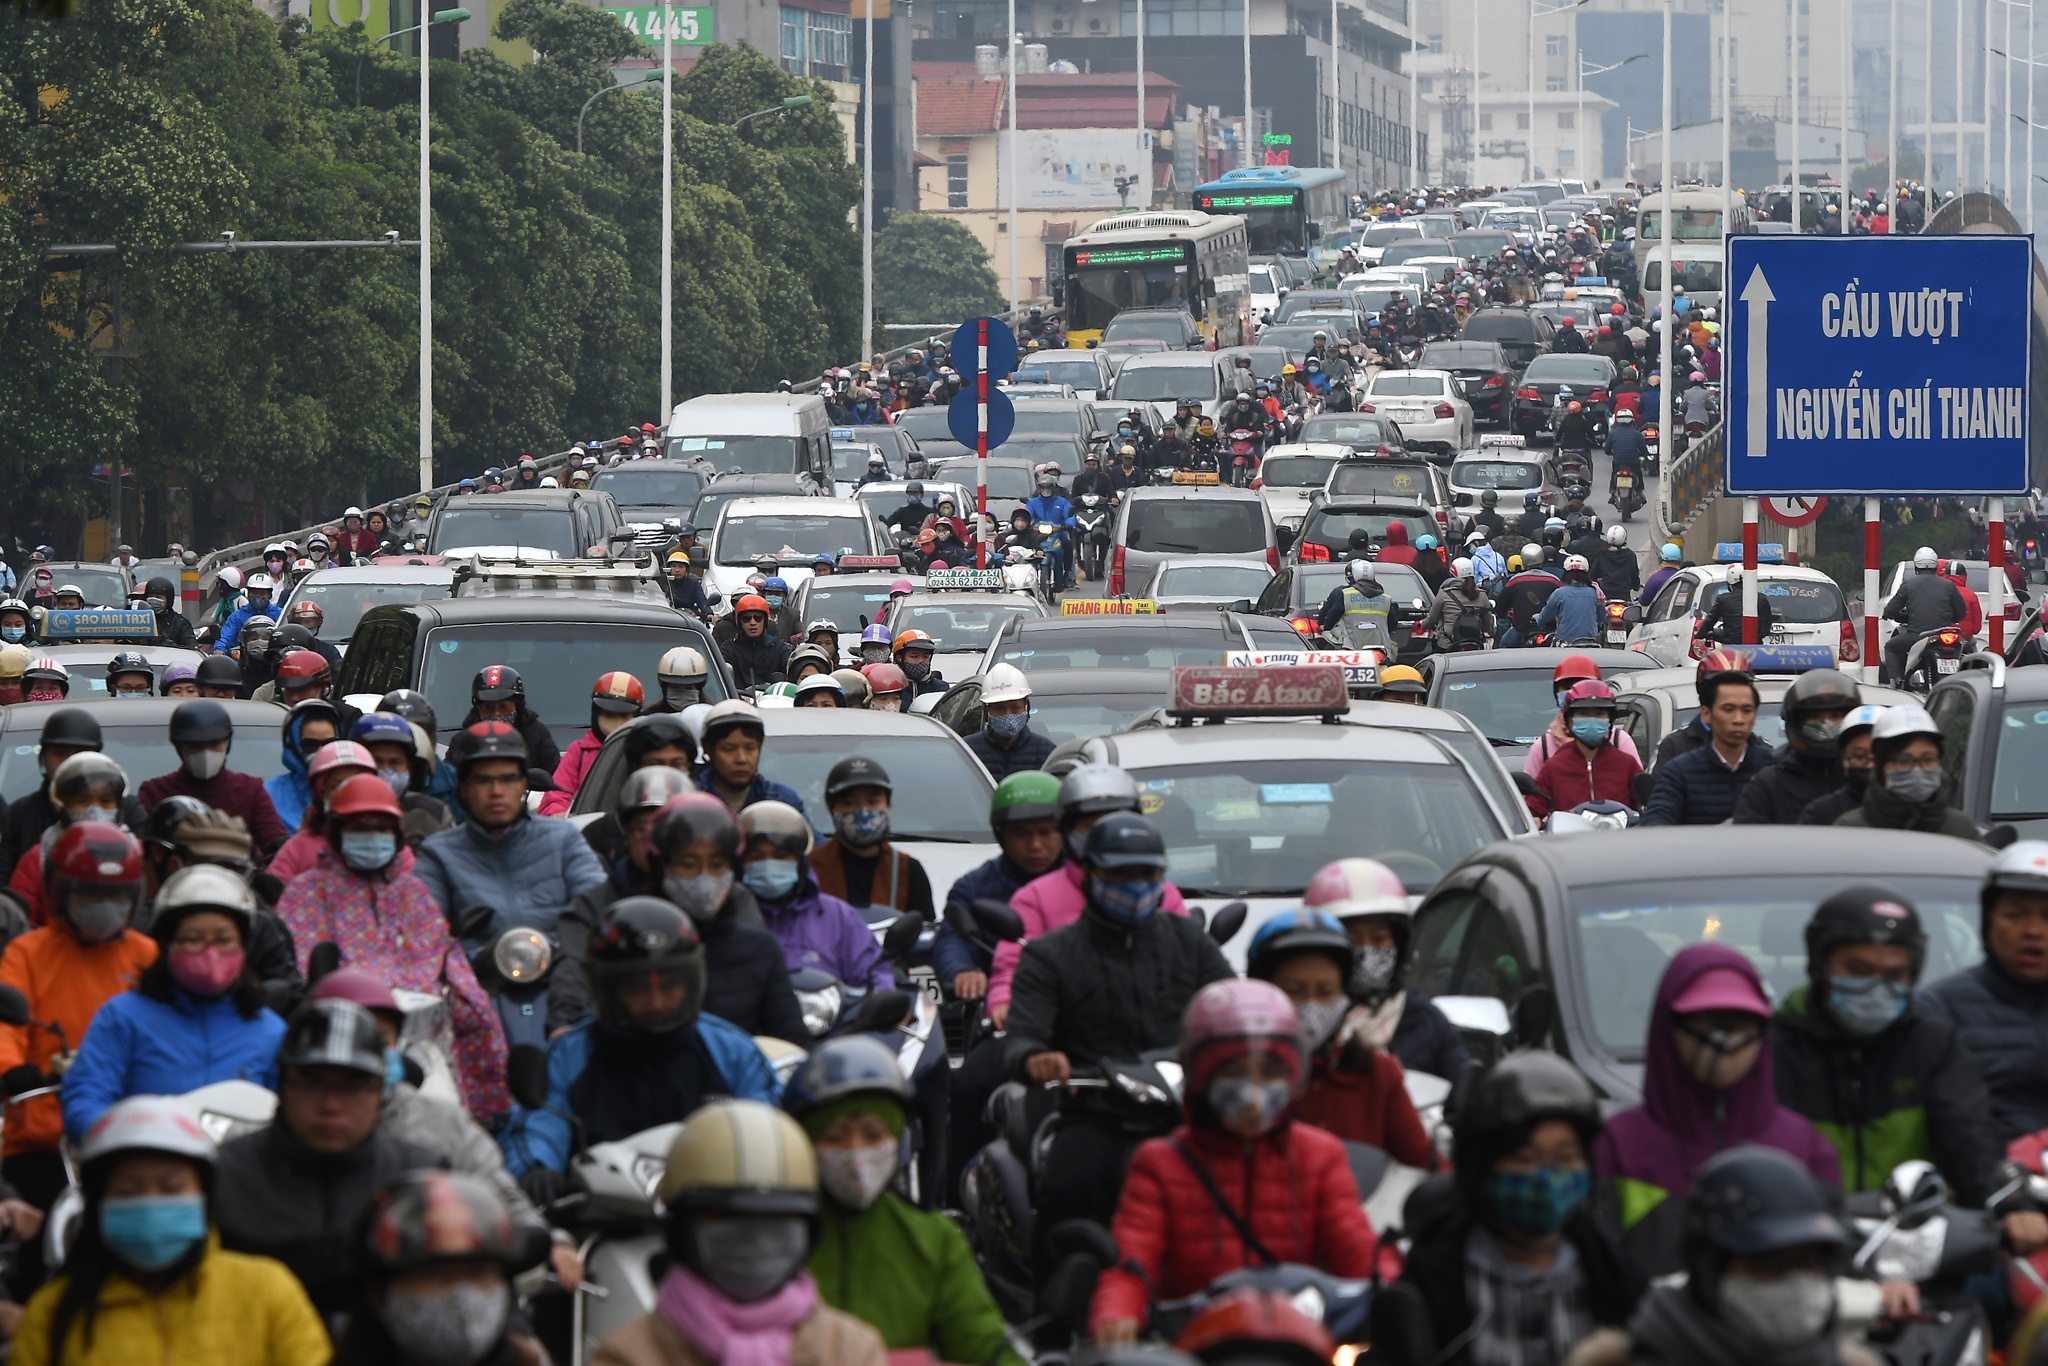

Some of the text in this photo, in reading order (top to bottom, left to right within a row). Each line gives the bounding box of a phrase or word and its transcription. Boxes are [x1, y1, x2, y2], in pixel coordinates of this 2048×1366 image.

[1821, 277, 1963, 344] CẦU VƯỢT
[1776, 370, 2022, 440] NGUYỄN CHÍ THANH
[1790, 586, 1819, 597] Taxi
[74, 614, 99, 624] SAO
[101, 614, 122, 624] MAI
[1304, 652, 1363, 665] Taxi
[1780, 657, 1812, 665] TAXI
[1274, 683, 1323, 703] taxi
